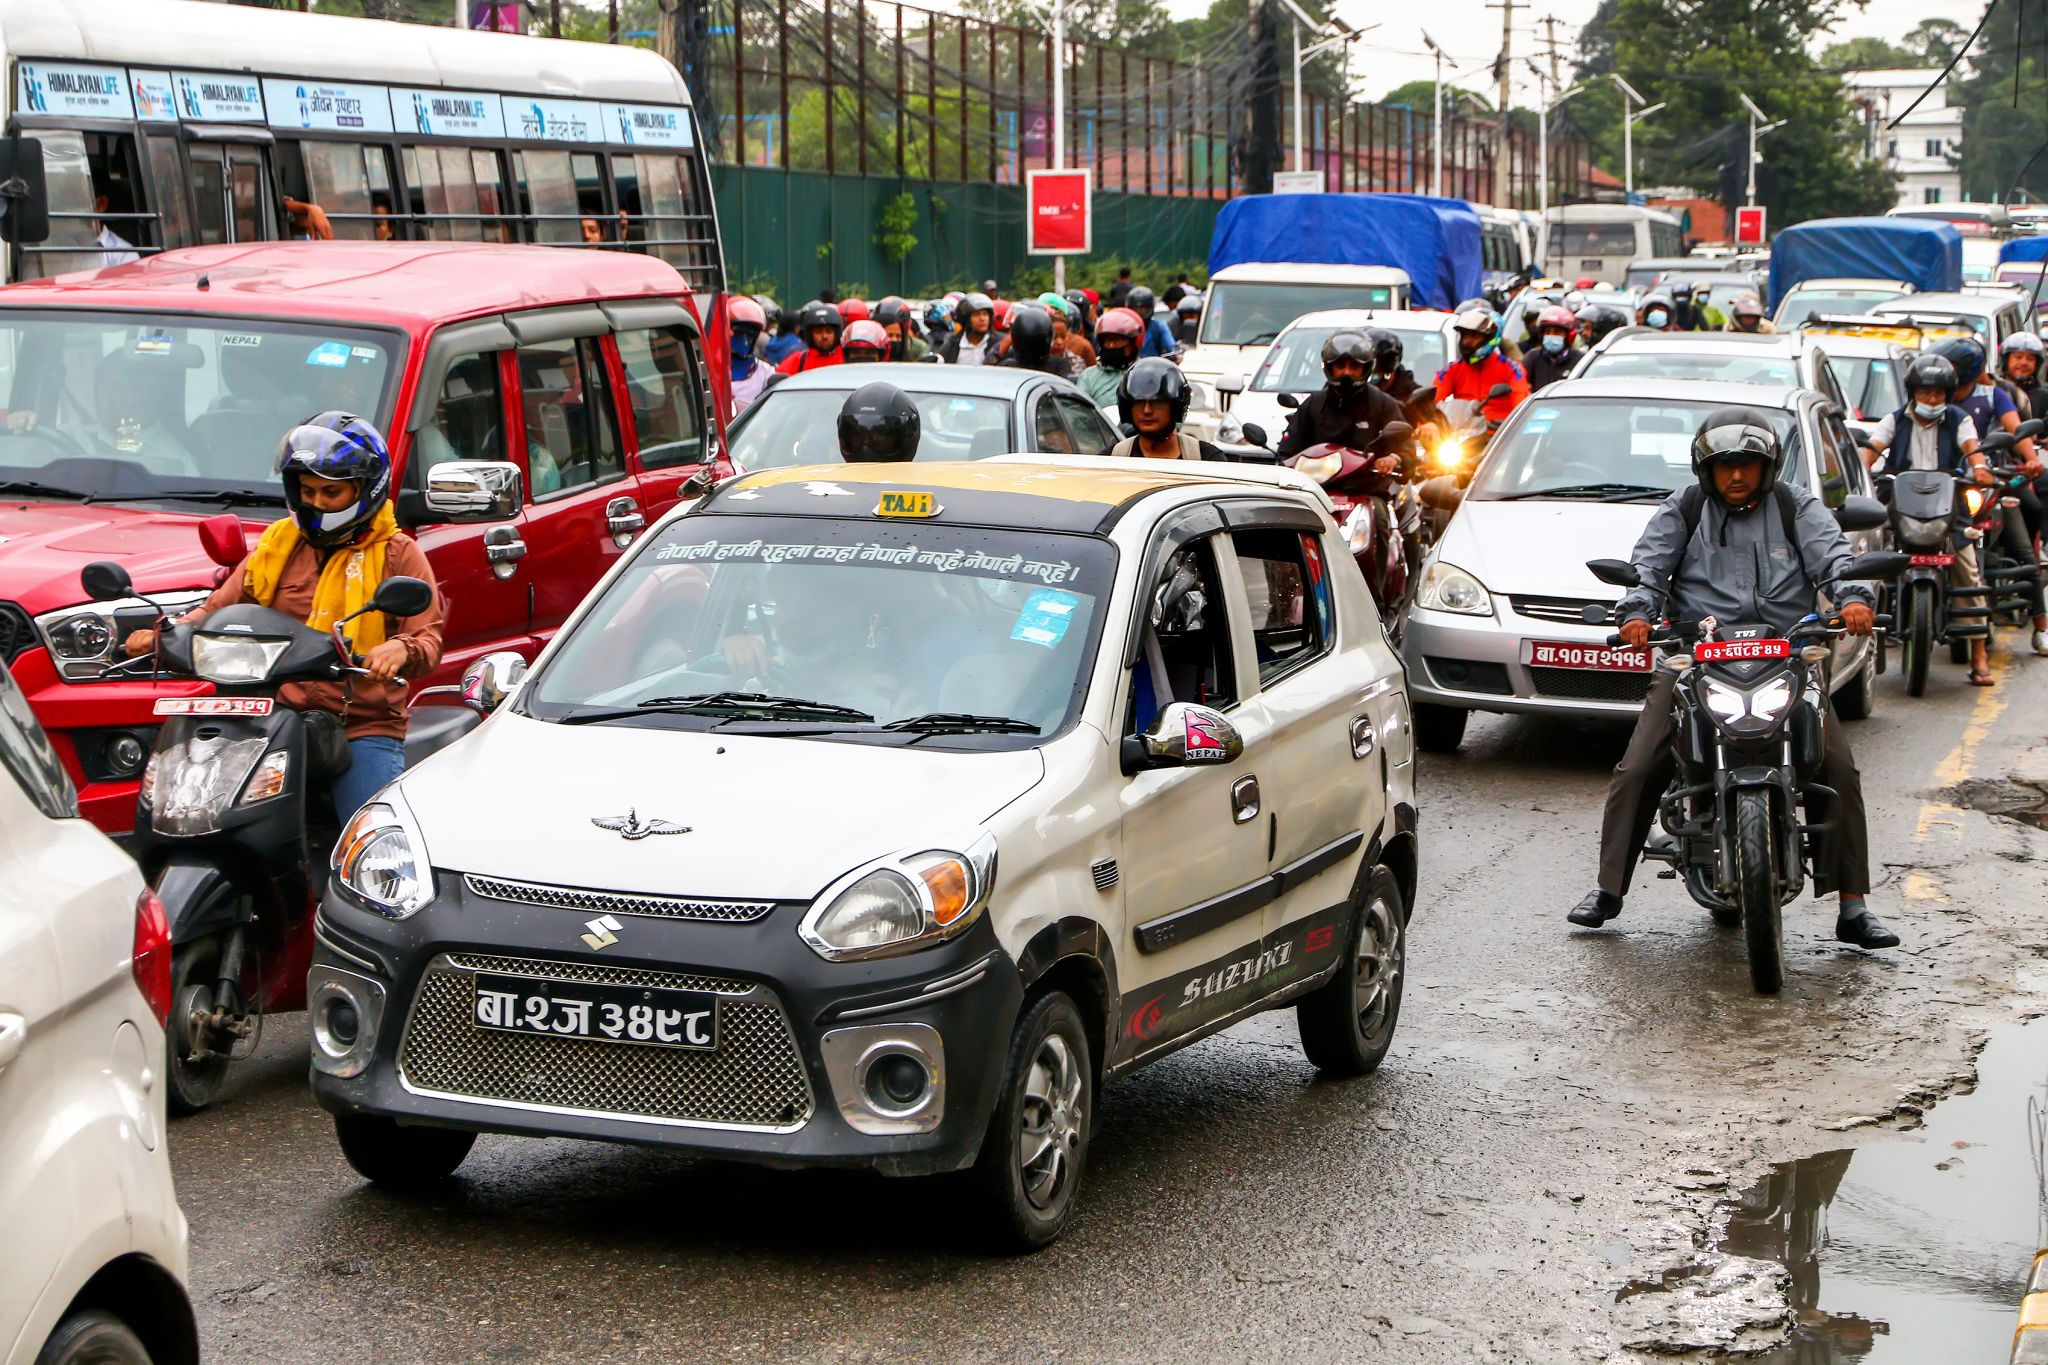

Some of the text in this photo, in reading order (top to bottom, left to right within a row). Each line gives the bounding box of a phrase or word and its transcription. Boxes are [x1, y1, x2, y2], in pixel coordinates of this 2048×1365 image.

[47, 72, 101, 95] HIMALAYAN
[200, 82, 245, 102] HIMALAYAN
[431, 98, 472, 118] HIMALAYAN
[632, 111, 668, 129] HIMALAYAN
[222, 335, 259, 345] NEPAL
[656, 539, 718, 560] नेपाली
[713, 539, 763, 561] हामी
[813, 542, 864, 563] कहाँ
[860, 543, 918, 565] नेपालै
[1734, 629, 1757, 638] TVS
[1187, 749, 1226, 759] NEPAL
[1178, 940, 1294, 1008] SUZUKI
